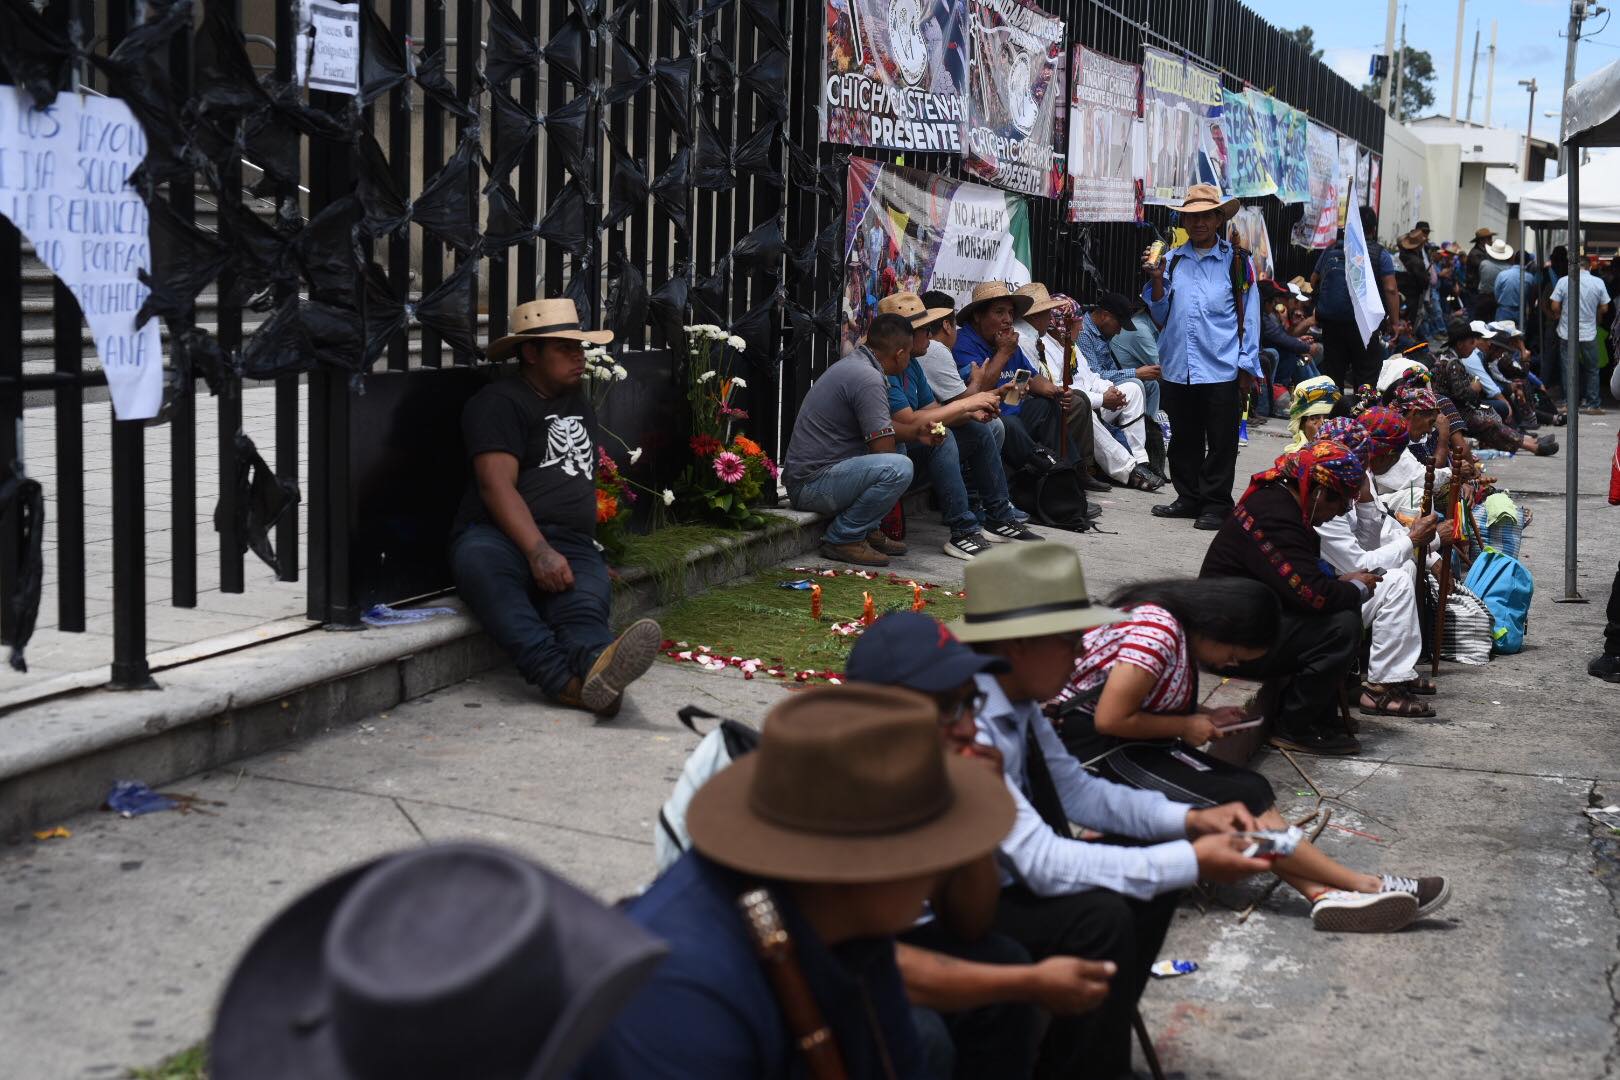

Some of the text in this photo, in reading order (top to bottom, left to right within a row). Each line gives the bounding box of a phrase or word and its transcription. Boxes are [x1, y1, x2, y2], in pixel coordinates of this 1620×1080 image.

[871, 115, 961, 150] PRESENTE
[996, 161, 1041, 193] PRESENTE
[954, 200, 1004, 233] NO A LA LEY
[932, 270, 947, 291] Desde
